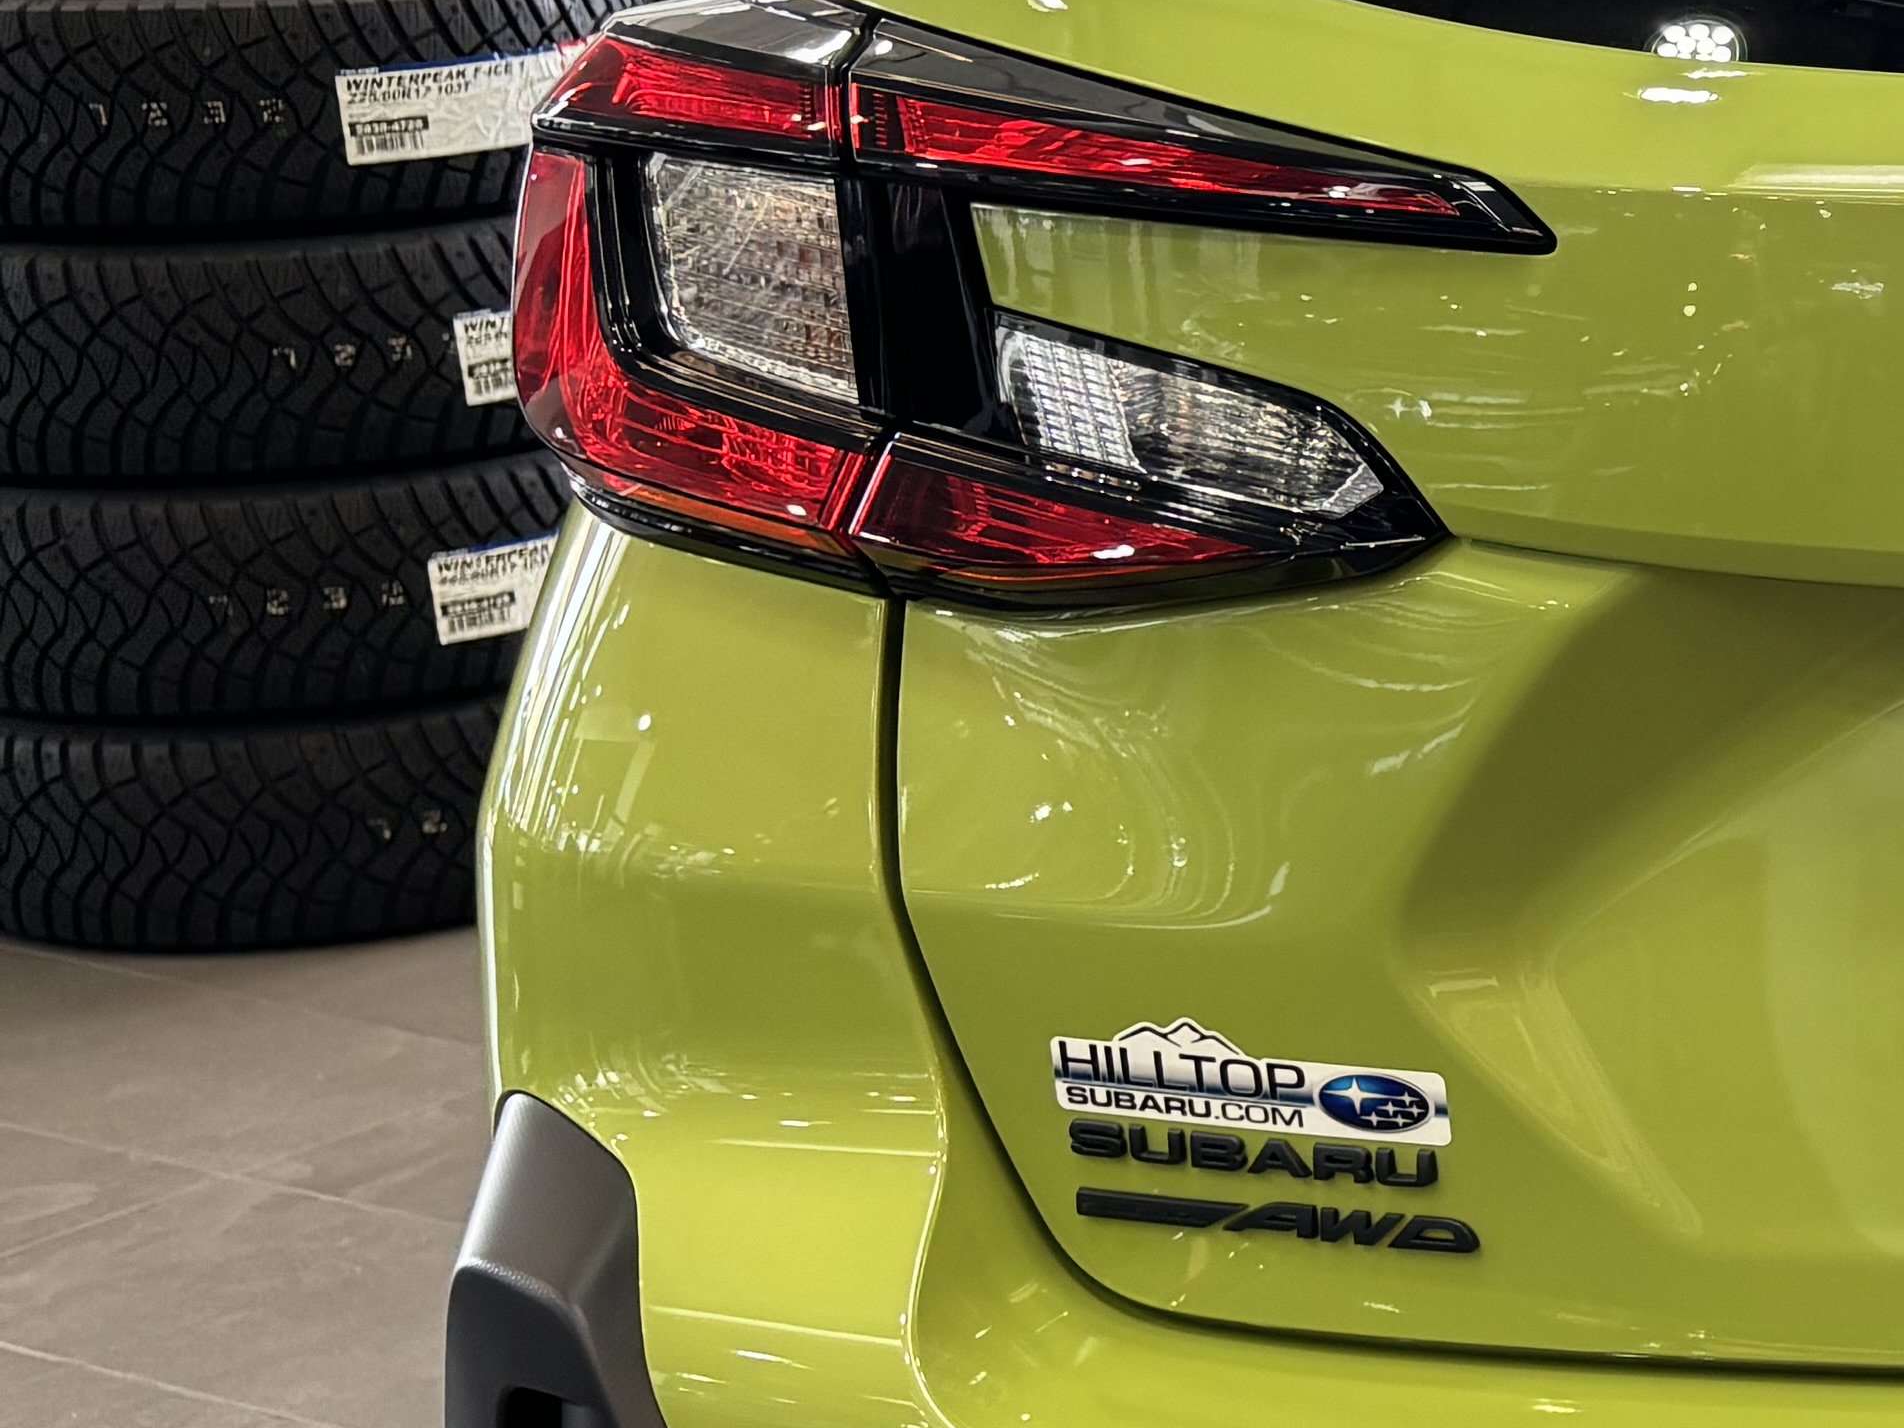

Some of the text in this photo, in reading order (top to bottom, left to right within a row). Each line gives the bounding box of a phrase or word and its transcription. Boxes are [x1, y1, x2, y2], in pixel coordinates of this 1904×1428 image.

[346, 67, 467, 92] WINTERPEAK
[1058, 1041, 1307, 1100] HILLTOP
[1066, 1086, 1305, 1128] SUBARU.COM
[1069, 1119, 1439, 1188] SUBARU
[1223, 1202, 1480, 1253] AWD
